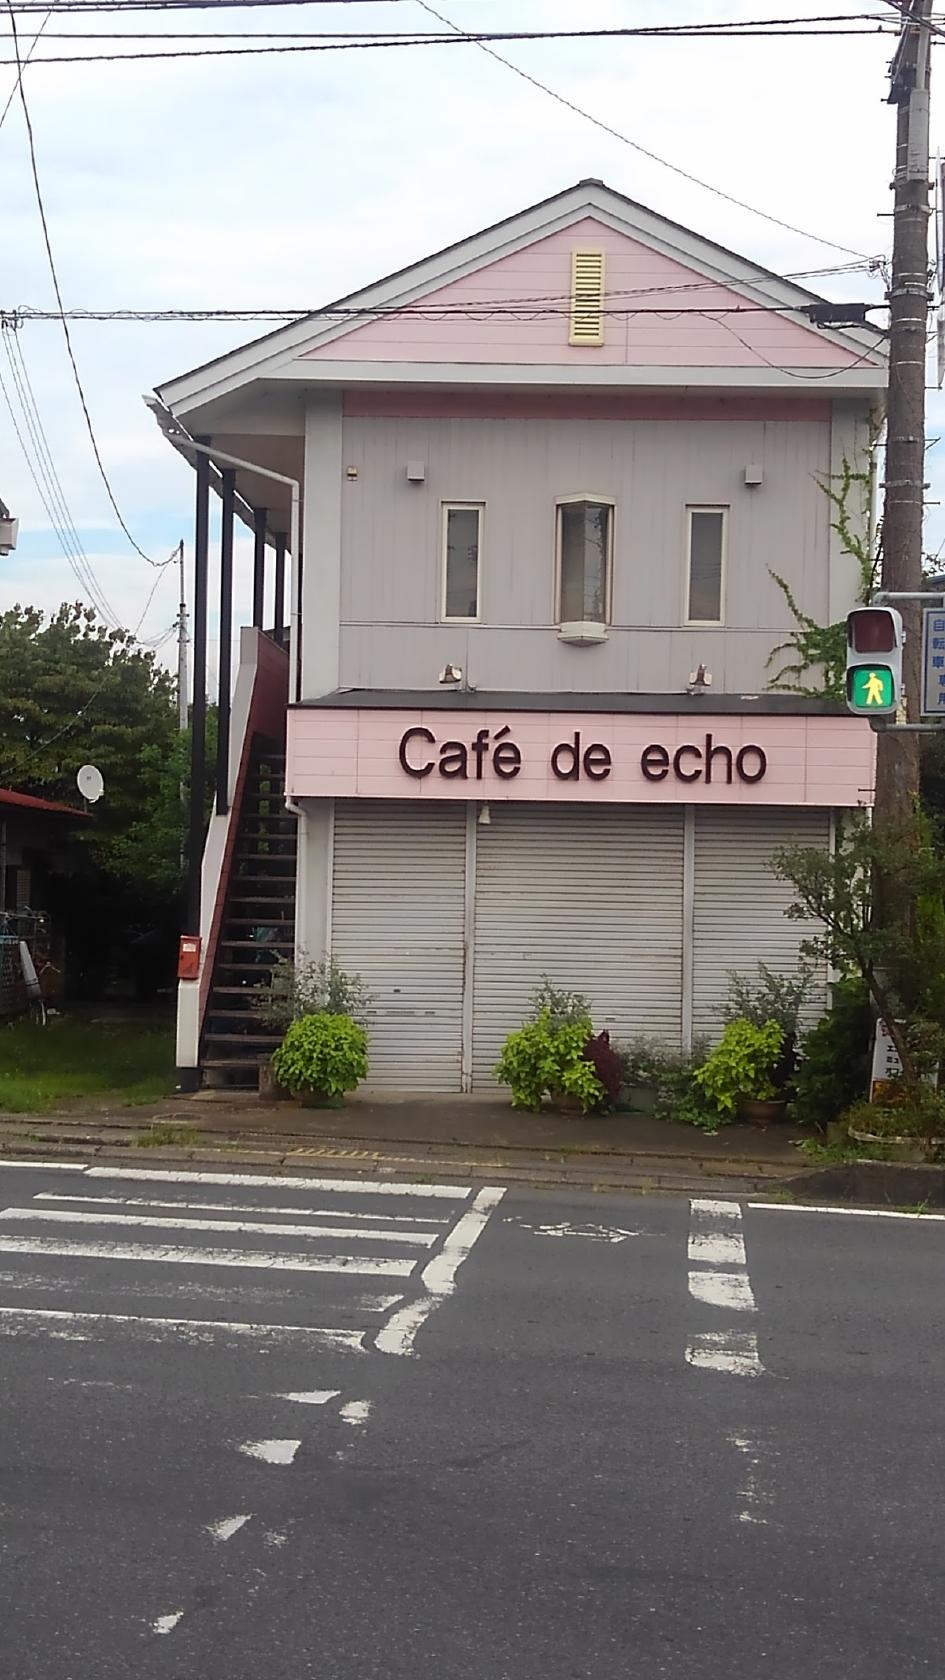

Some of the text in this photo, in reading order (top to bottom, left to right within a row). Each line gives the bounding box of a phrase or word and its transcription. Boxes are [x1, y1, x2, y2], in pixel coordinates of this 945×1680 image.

[399, 725, 767, 784] Café de echo
